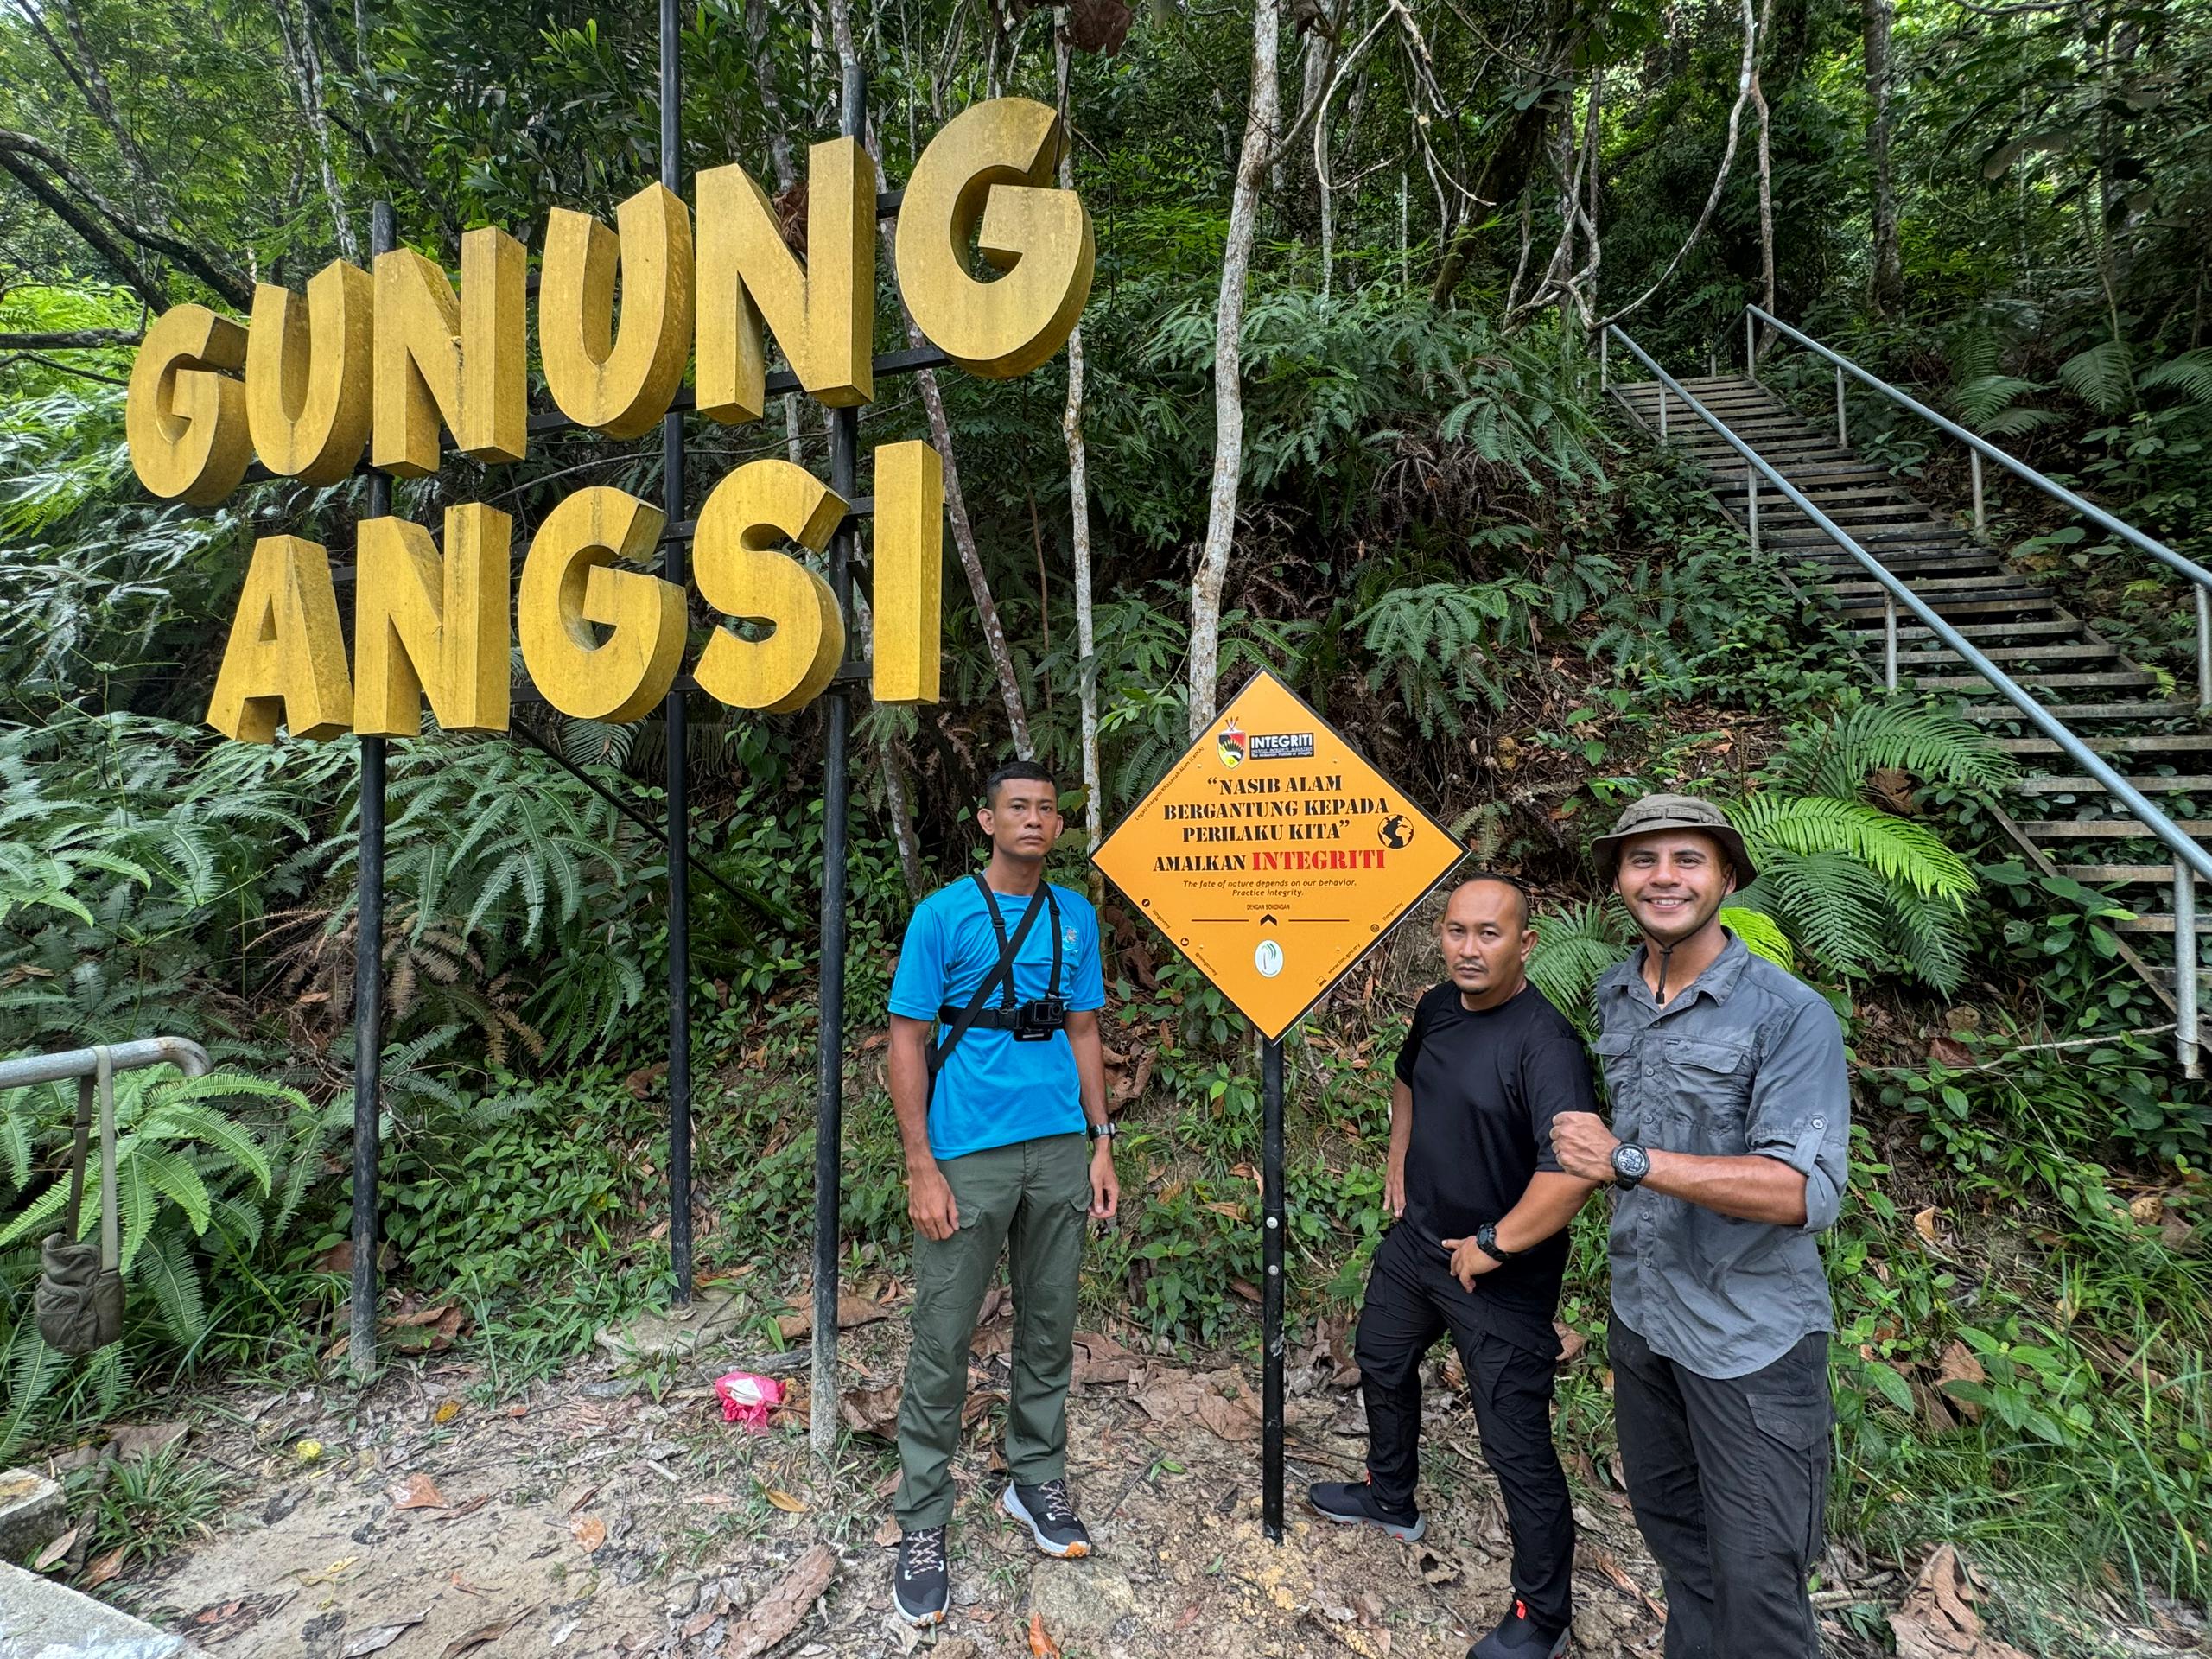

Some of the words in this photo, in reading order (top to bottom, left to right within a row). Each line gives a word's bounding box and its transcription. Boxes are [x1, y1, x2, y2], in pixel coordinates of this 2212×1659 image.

[125, 97, 1095, 506] GUNUNG
[206, 440, 944, 745] ANGSI
[1250, 734, 1313, 749] INTEGRITI
[1207, 777, 1281, 796] “NASIB
[1285, 775, 1342, 793] ALAM
[1164, 800, 1299, 821] BERGANTUNG
[1305, 798, 1389, 816] KEPADA
[1183, 824, 1283, 842] PERILAKU
[1289, 819, 1351, 840] KITA”
[1153, 855, 1247, 872] AMALKAN
[1253, 849, 1386, 871] INTEGRITI
[1198, 880, 1216, 889] fate
[1217, 880, 1227, 889] of
[1255, 879, 1288, 889] depends
